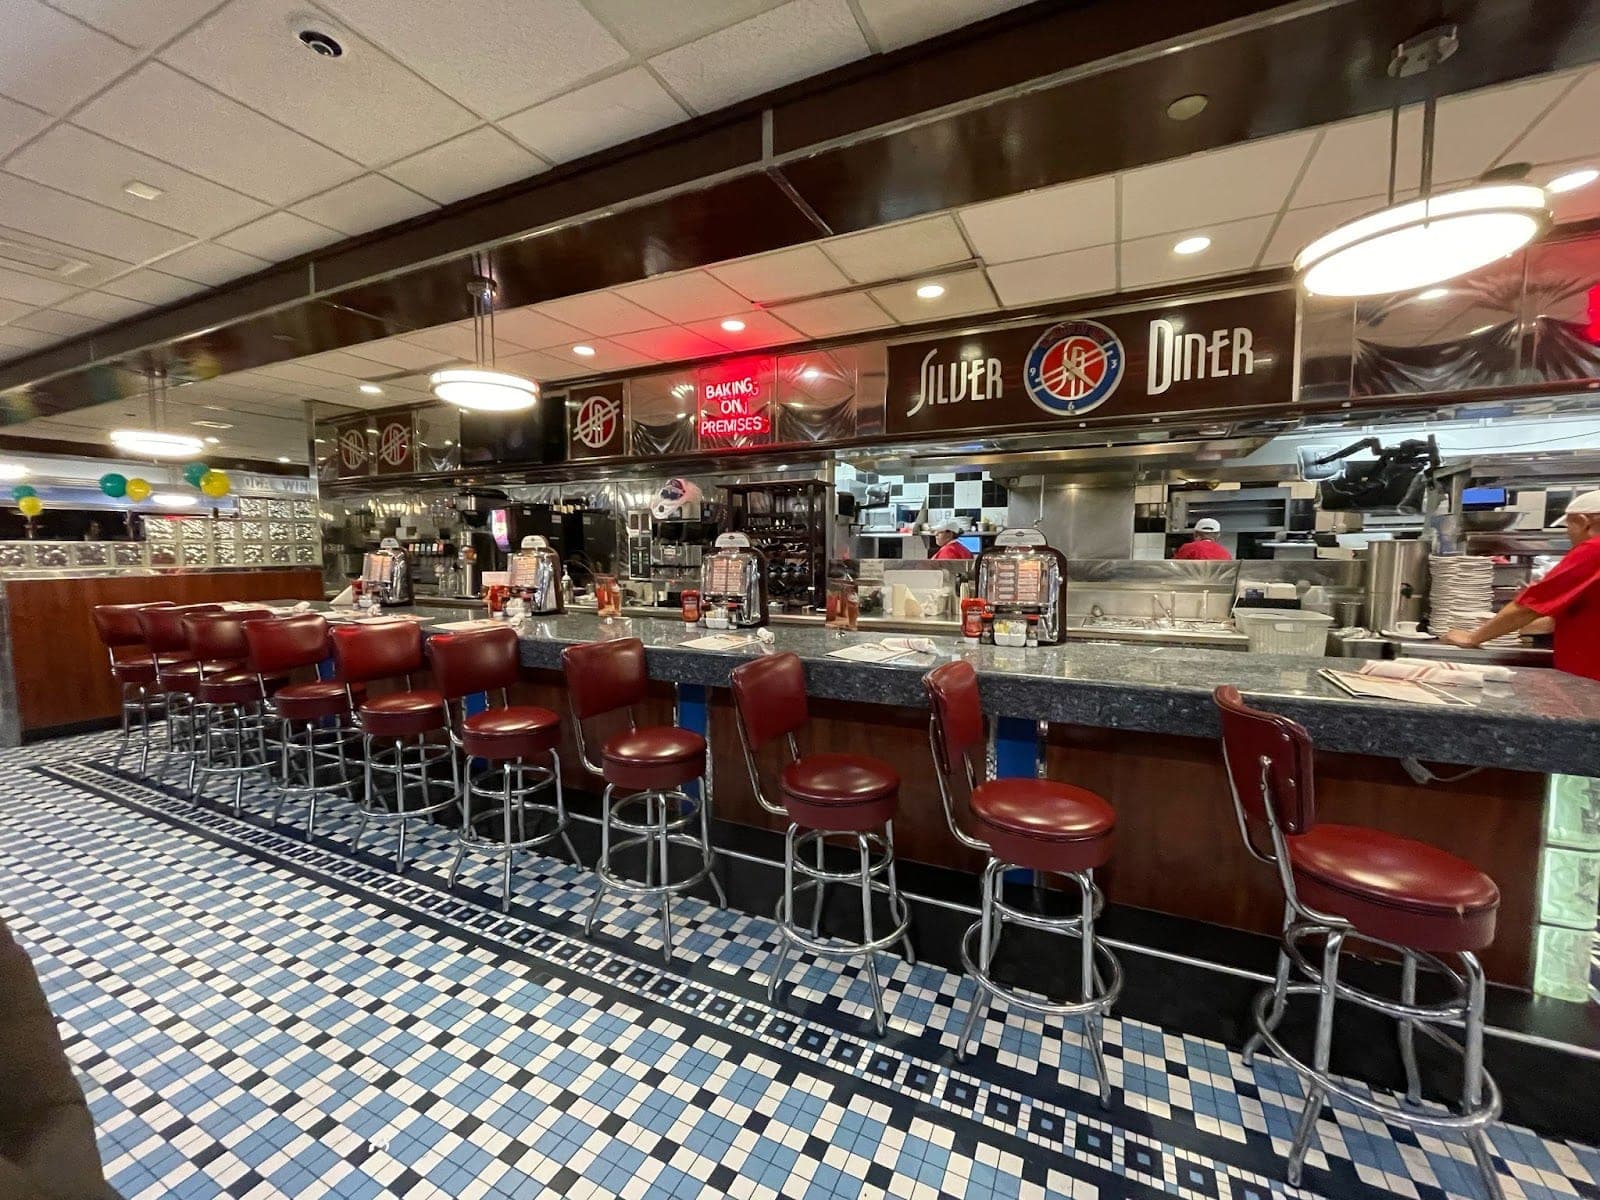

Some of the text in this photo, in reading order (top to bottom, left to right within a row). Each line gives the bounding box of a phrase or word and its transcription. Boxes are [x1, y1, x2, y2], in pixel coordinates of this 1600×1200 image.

[907, 319, 1254, 417] SILVER DINER
[706, 377, 753, 399] BAKING
[721, 399, 743, 414] ON
[701, 416, 762, 435] PREMISES
